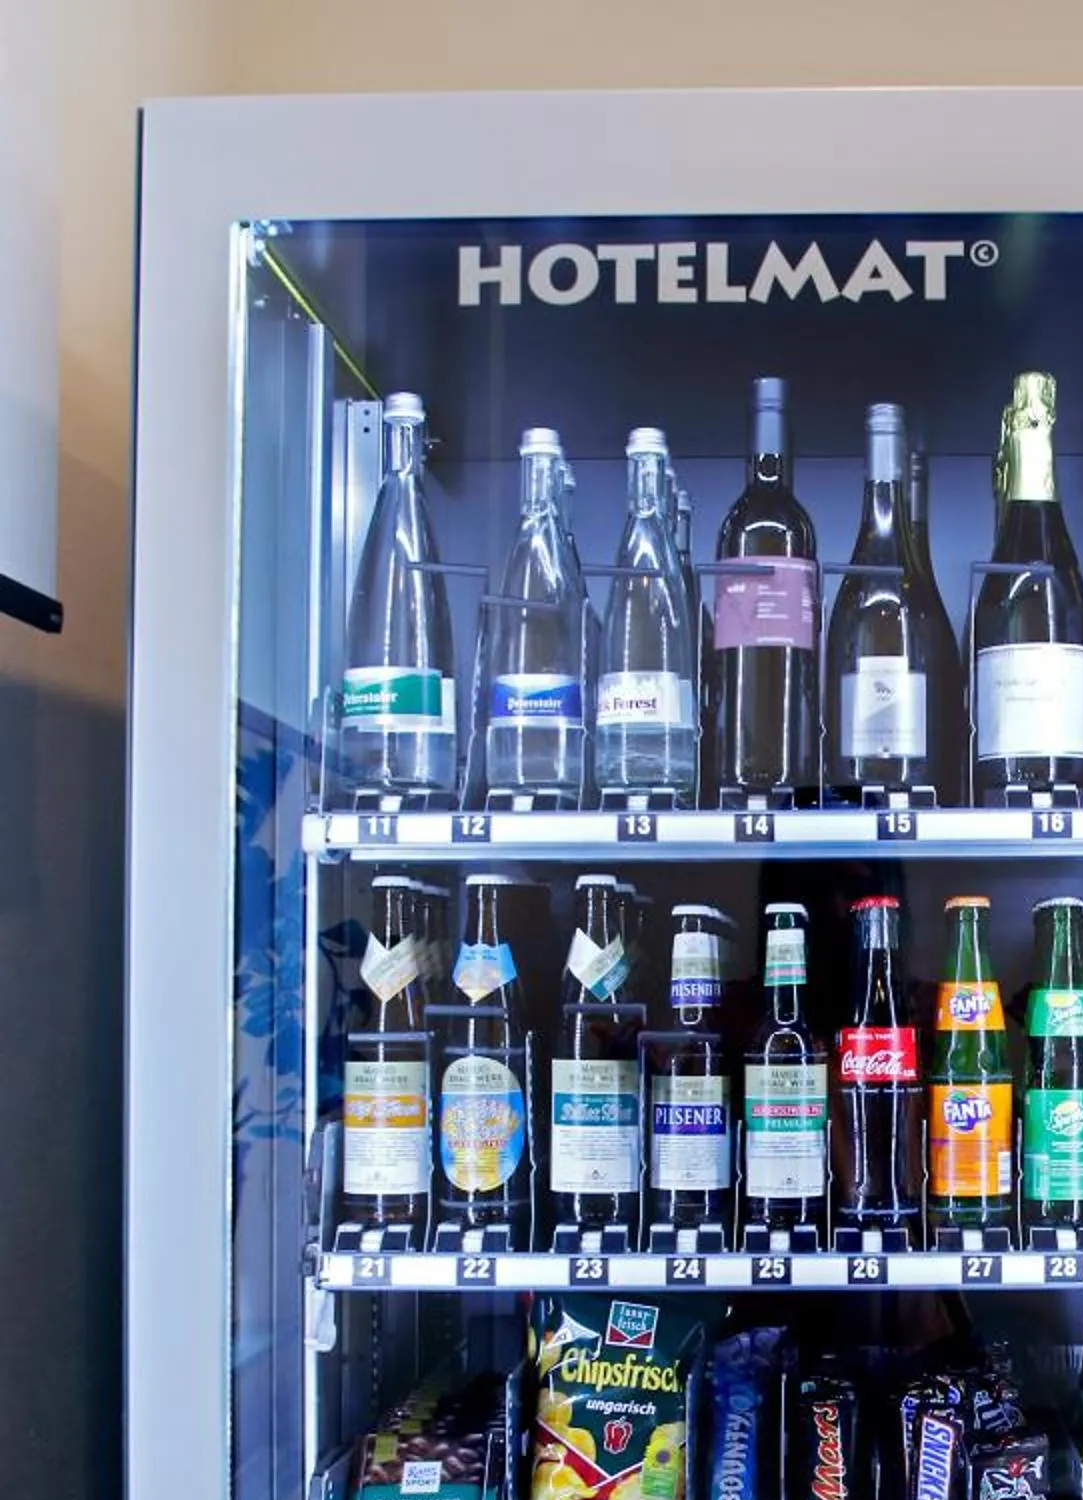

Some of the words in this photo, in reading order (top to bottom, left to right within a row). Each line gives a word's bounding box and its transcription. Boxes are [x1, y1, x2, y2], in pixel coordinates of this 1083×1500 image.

[367, 816, 391, 834] 11
[460, 816, 484, 835] 12
[625, 816, 650, 835] 13
[743, 815, 768, 834] 14
[886, 814, 910, 832] 15
[1040, 812, 1064, 832] 16
[842, 1050, 905, 1076] Coca-Cola
[655, 1106, 723, 1125] PILSENER
[943, 1099, 992, 1122] FANTA
[361, 1259, 384, 1277] 21
[464, 1259, 489, 1278] 22
[576, 1259, 602, 1278] 23
[674, 1259, 700, 1278] 24
[759, 1258, 784, 1278] 25
[854, 1258, 878, 1278] 26
[968, 1257, 993, 1277] 27
[1051, 1257, 1076, 1276] 28
[585, 1399, 657, 1416] ungarisch
